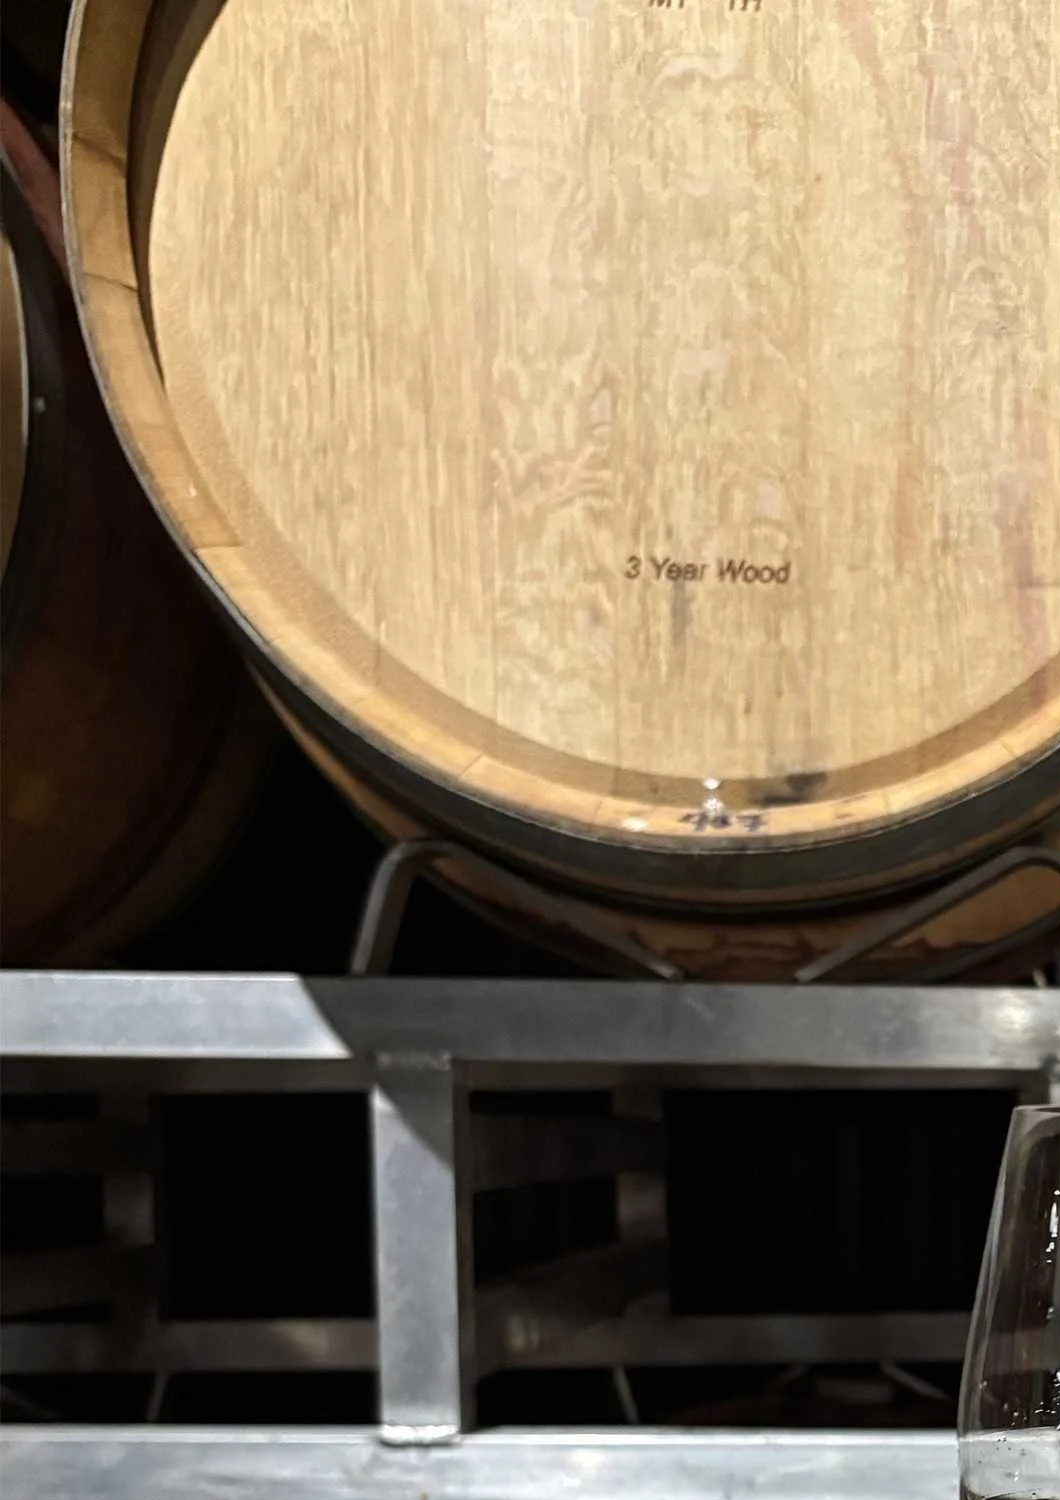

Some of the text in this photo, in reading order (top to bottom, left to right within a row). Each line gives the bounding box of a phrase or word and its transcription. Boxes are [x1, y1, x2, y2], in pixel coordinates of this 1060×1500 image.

[625, 555, 792, 584] 3 Year Wood
